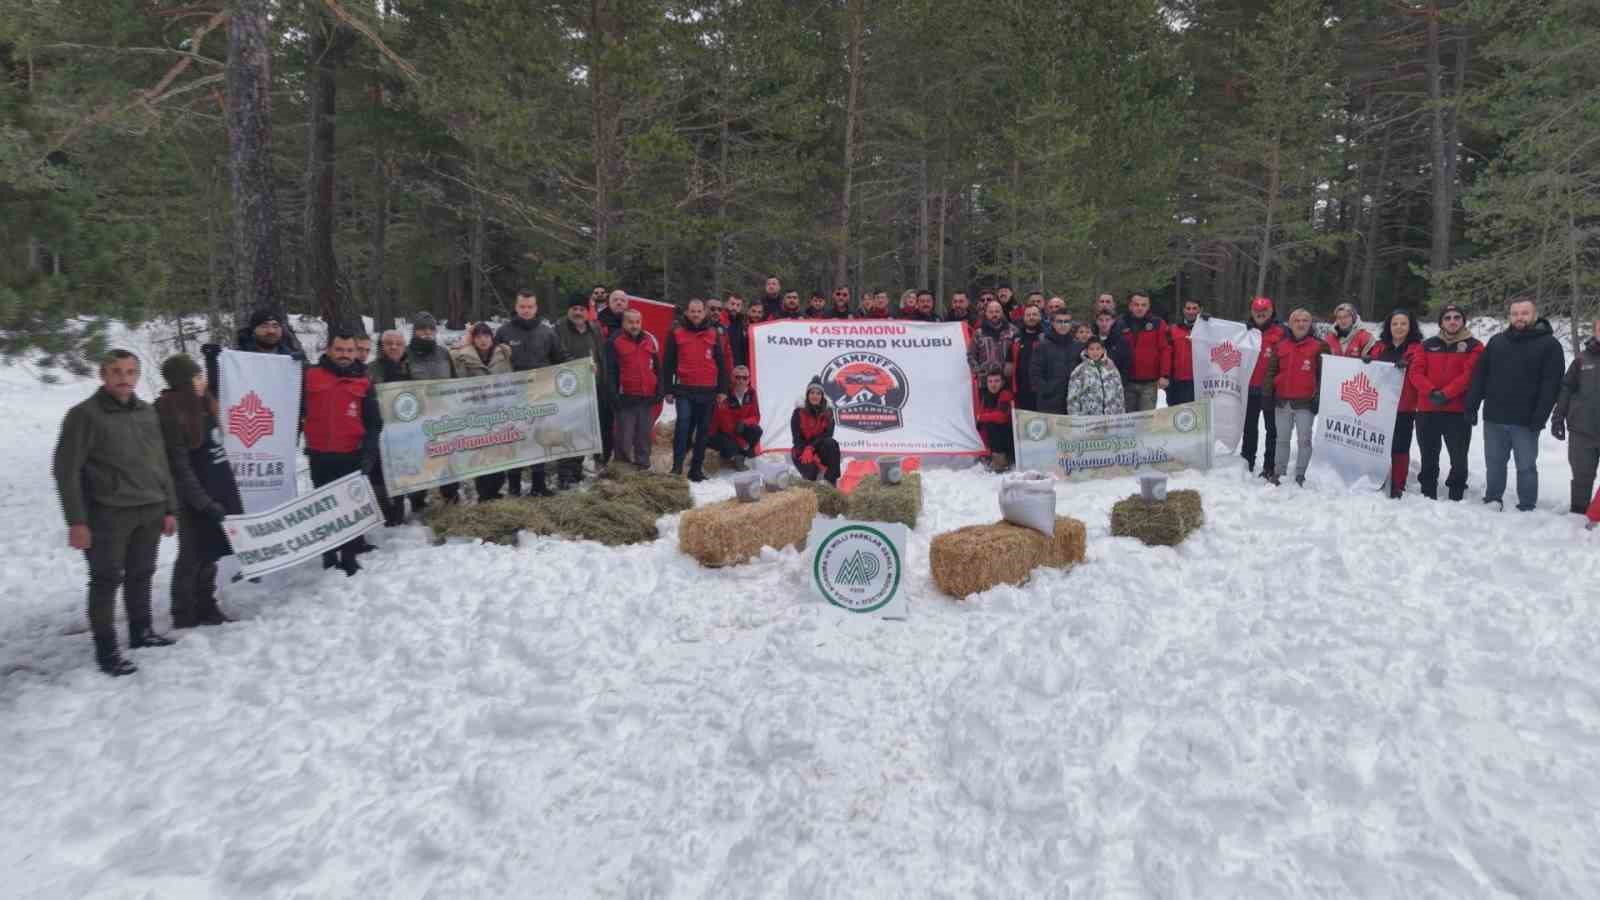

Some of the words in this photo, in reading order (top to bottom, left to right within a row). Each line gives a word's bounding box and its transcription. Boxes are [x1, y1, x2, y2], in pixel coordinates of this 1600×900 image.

[809, 325, 906, 336] KASTAMONU
[767, 335, 813, 347] KAMP
[817, 336, 887, 348] OFFROAD
[834, 354, 893, 369] KAMPOFF
[1202, 379, 1242, 393] VAKIFLA
[1326, 418, 1385, 446] VAKIFLAR
[283, 494, 338, 529] HAYATI
